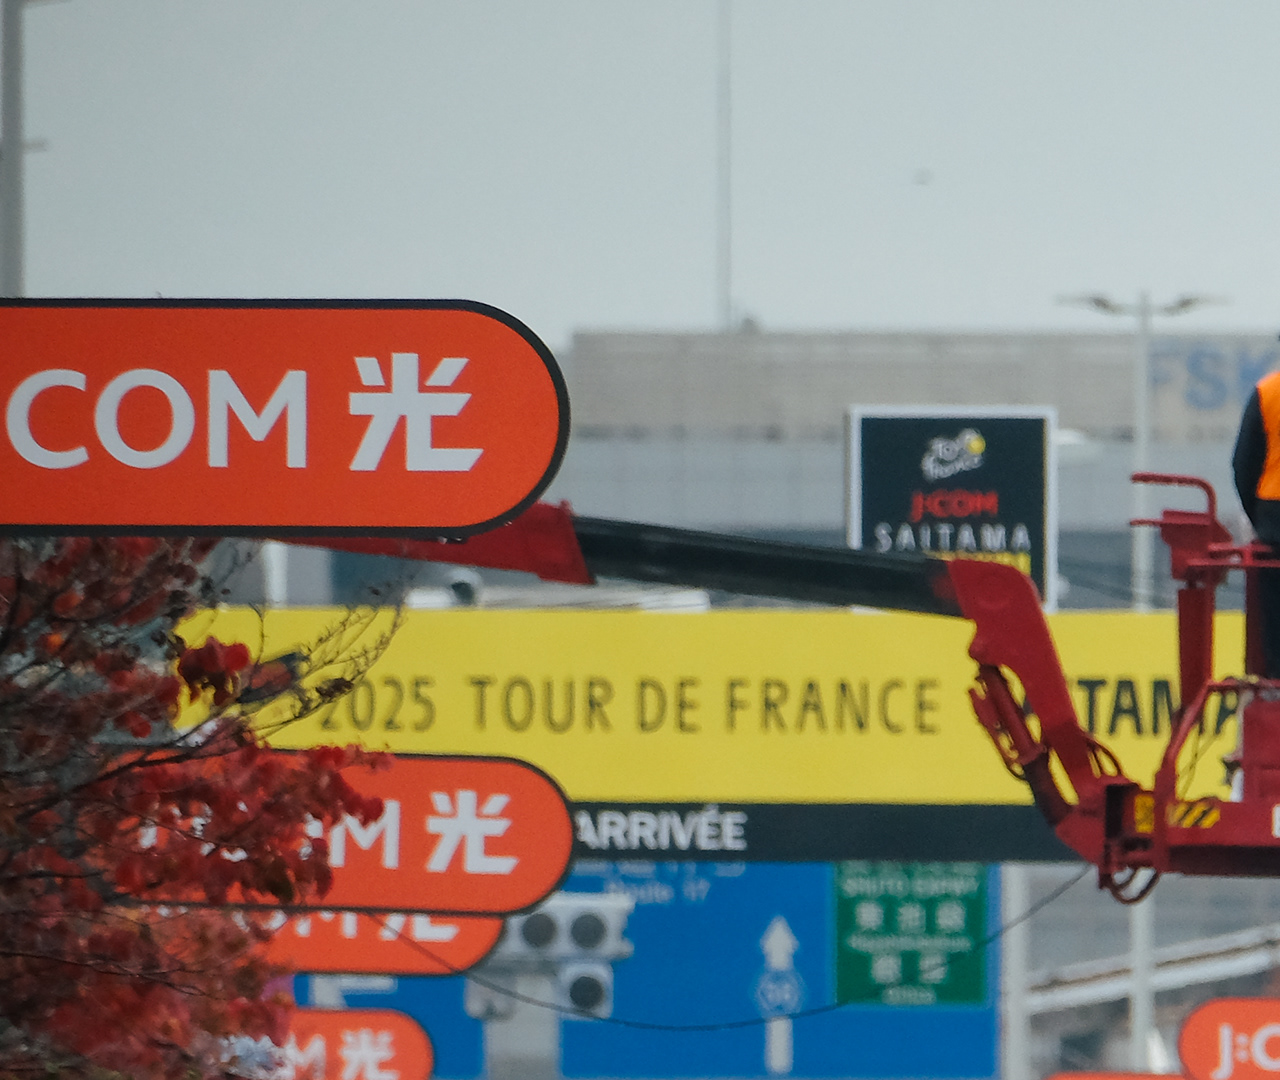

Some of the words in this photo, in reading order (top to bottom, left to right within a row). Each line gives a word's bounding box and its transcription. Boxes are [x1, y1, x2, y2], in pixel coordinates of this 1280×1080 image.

[348, 352, 484, 472] 光
[874, 522, 1032, 553] SAITAMA
[471, 676, 614, 734] TOUR
[637, 677, 702, 733] DE
[726, 677, 941, 735] FRANCE
[426, 790, 520, 876] 光
